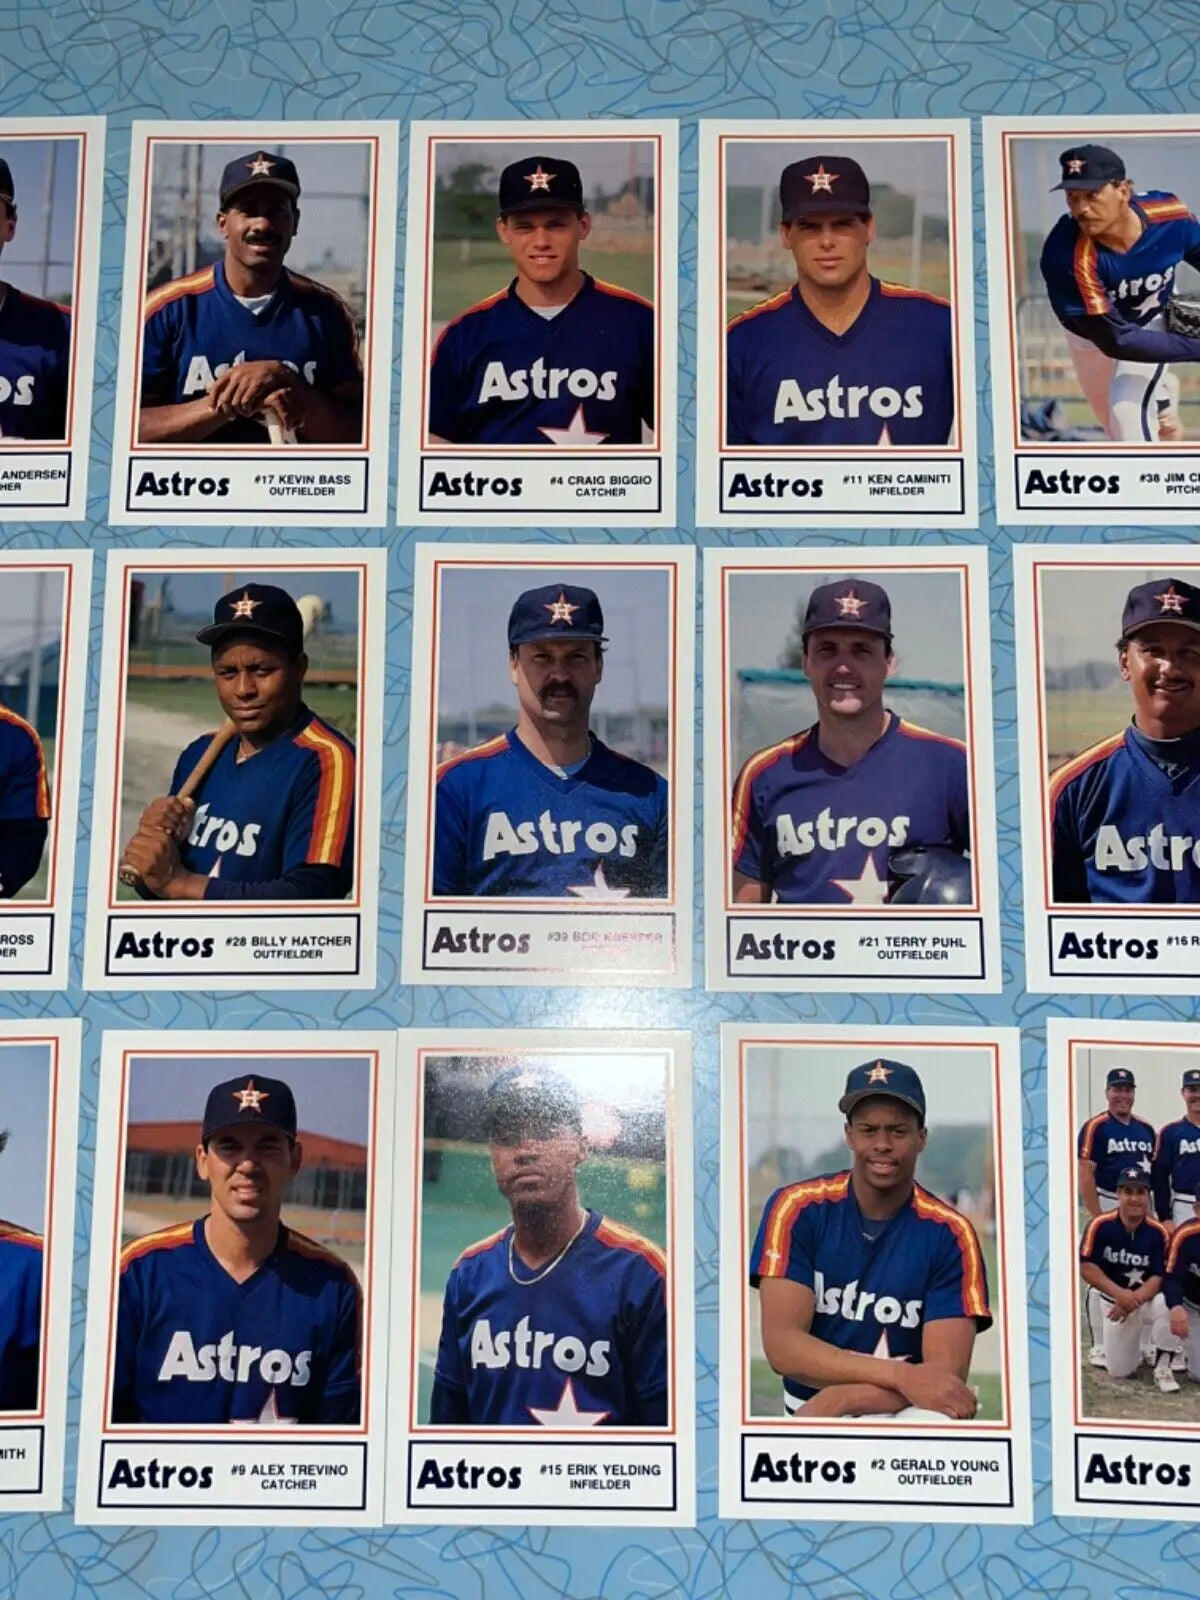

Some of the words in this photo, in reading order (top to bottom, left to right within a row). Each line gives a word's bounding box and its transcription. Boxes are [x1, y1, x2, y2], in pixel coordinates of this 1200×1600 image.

[478, 356, 619, 405] Astros
[773, 373, 924, 425] Astros
[0, 469, 67, 481] ANDERSEN
[254, 474, 275, 485] #17
[278, 474, 316, 485] KEVIN
[318, 474, 352, 485] BASS
[549, 476, 564, 486] #4
[567, 475, 606, 486] CRAIG
[609, 475, 653, 486] BIGGIO
[842, 475, 863, 485] #11
[867, 473, 893, 485] KEN
[896, 473, 952, 485] CAMINITI
[1023, 468, 1120, 495] Astros
[1139, 472, 1161, 484] #38
[1164, 472, 1186, 483] JIM
[134, 470, 231, 497] Astros
[427, 471, 523, 497] Astros
[727, 472, 824, 499] Astros
[869, 486, 925, 496] INFIELDER
[268, 486, 336, 497] OUTFIELDER
[575, 487, 627, 498] CATCHER
[482, 809, 638, 861] Astros
[775, 806, 911, 857] Astros
[114, 930, 215, 960] Astros
[225, 935, 247, 947] #28
[250, 935, 288, 947] BILLY
[291, 935, 352, 947] HATCHER
[431, 925, 532, 954] Astros
[735, 932, 836, 961] Astros
[858, 936, 879, 948] #21
[885, 936, 928, 948] TERRY
[931, 936, 967, 949] PUHL
[1057, 931, 1159, 960] Astros
[1166, 935, 1189, 947] #16
[253, 948, 324, 960] OUTFIELDER
[877, 949, 949, 961] OUTFIELDER
[1107, 1138, 1153, 1154] Astros
[471, 1315, 611, 1377] Astros
[157, 1330, 312, 1387] Astros
[230, 1464, 247, 1476] #9
[250, 1464, 285, 1476] ALEX
[290, 1464, 349, 1477] TREVINO
[539, 1464, 563, 1476] #15
[567, 1463, 598, 1476] ERIK
[602, 1464, 662, 1477] YELDING
[749, 1452, 857, 1485] Astros
[870, 1458, 886, 1471] #2
[890, 1458, 946, 1472] GERALD
[950, 1459, 1000, 1473] YOUNG
[1083, 1453, 1192, 1488] Astros
[107, 1458, 214, 1490] Astros
[416, 1458, 522, 1490] Astros
[897, 1473, 973, 1486] OUTFIELDER
[260, 1478, 317, 1490] CATCHER
[569, 1478, 631, 1490] INFIELDER
